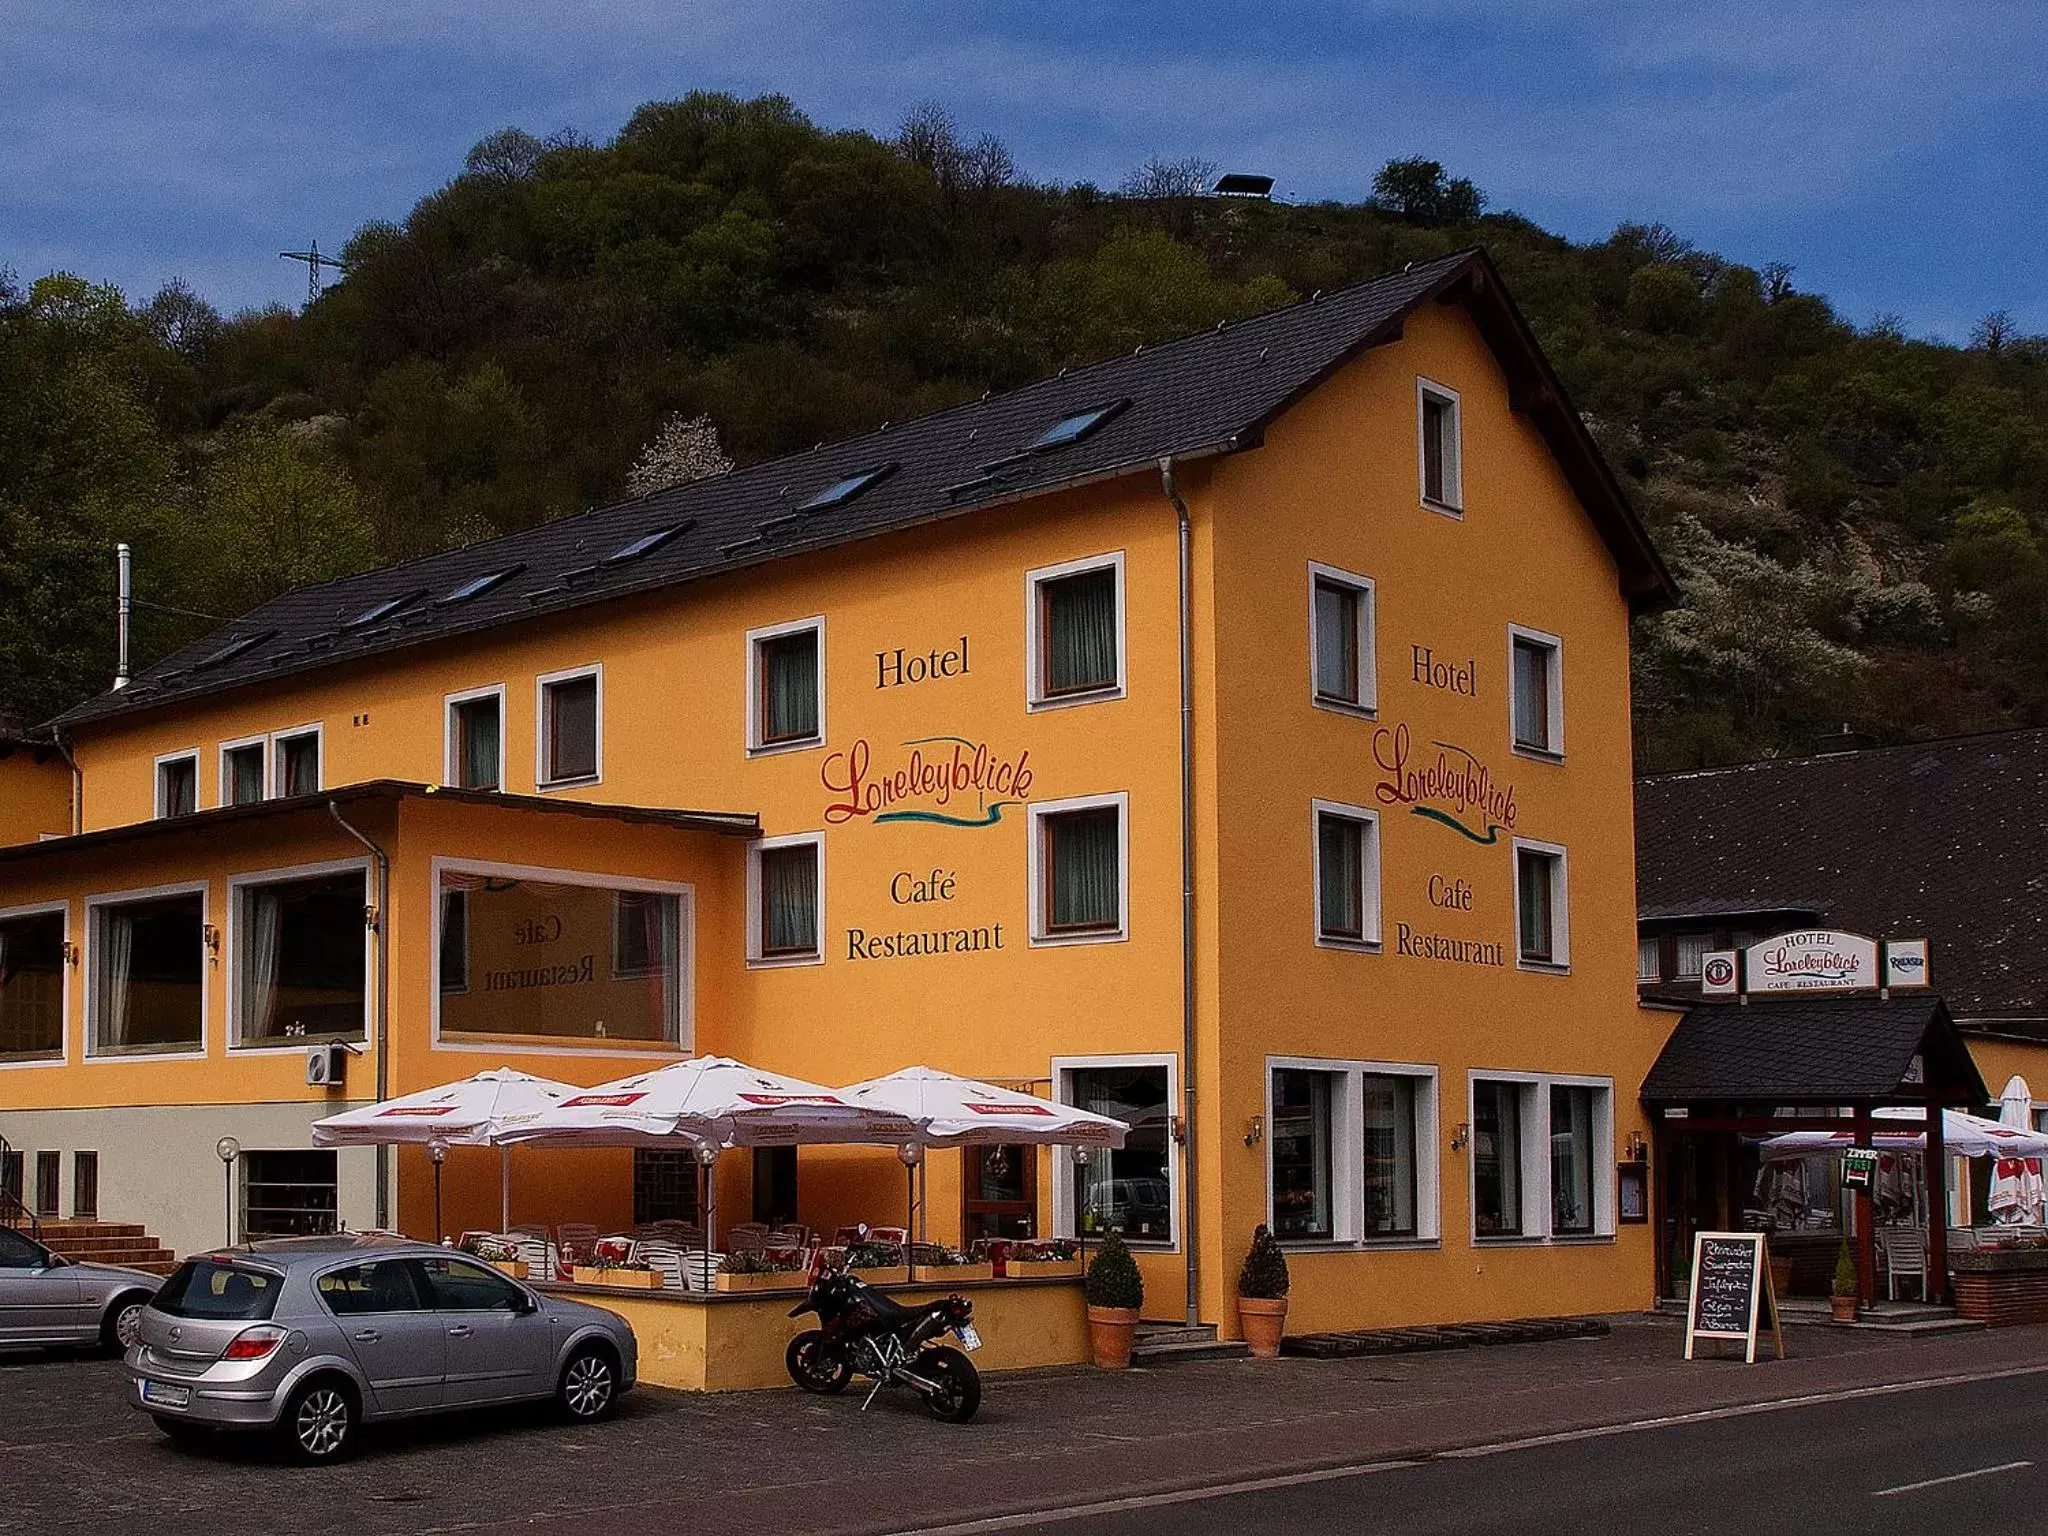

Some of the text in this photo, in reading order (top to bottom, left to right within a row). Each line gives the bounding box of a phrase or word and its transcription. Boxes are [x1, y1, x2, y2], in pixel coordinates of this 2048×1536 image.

[874, 636, 969, 689] Hotel
[1411, 645, 1476, 697] Hotel
[821, 739, 1033, 824] Loreleyblick
[1372, 723, 1516, 829] Loreleyblick
[891, 869, 956, 905] Café
[1428, 875, 1473, 912] Café
[846, 922, 1004, 960] Restaurant
[1396, 922, 1504, 967] Restaurant
[1784, 933, 1835, 948] HOTEL
[1763, 947, 1860, 975] Loreleyblick
[1797, 979, 1856, 988] RESTAURANT
